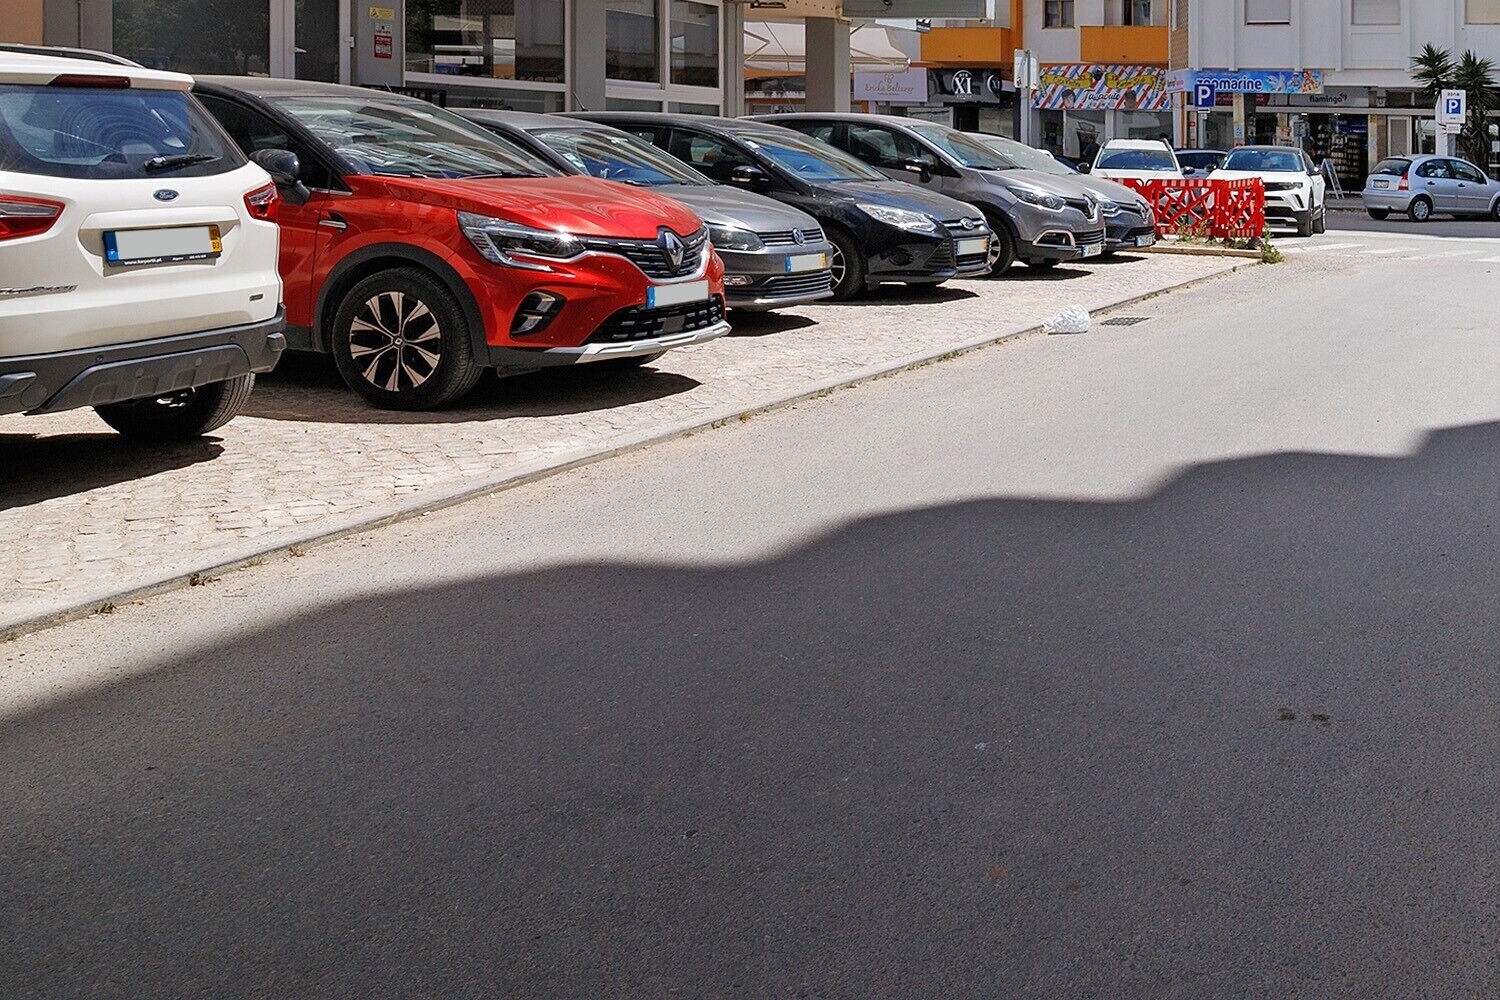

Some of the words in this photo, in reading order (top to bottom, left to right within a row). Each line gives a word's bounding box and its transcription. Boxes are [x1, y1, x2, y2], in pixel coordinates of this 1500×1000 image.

[953, 77, 973, 95] XI
[1198, 86, 1211, 106] P
[1309, 94, 1342, 105] flamingo
[1448, 99, 1459, 114] P
